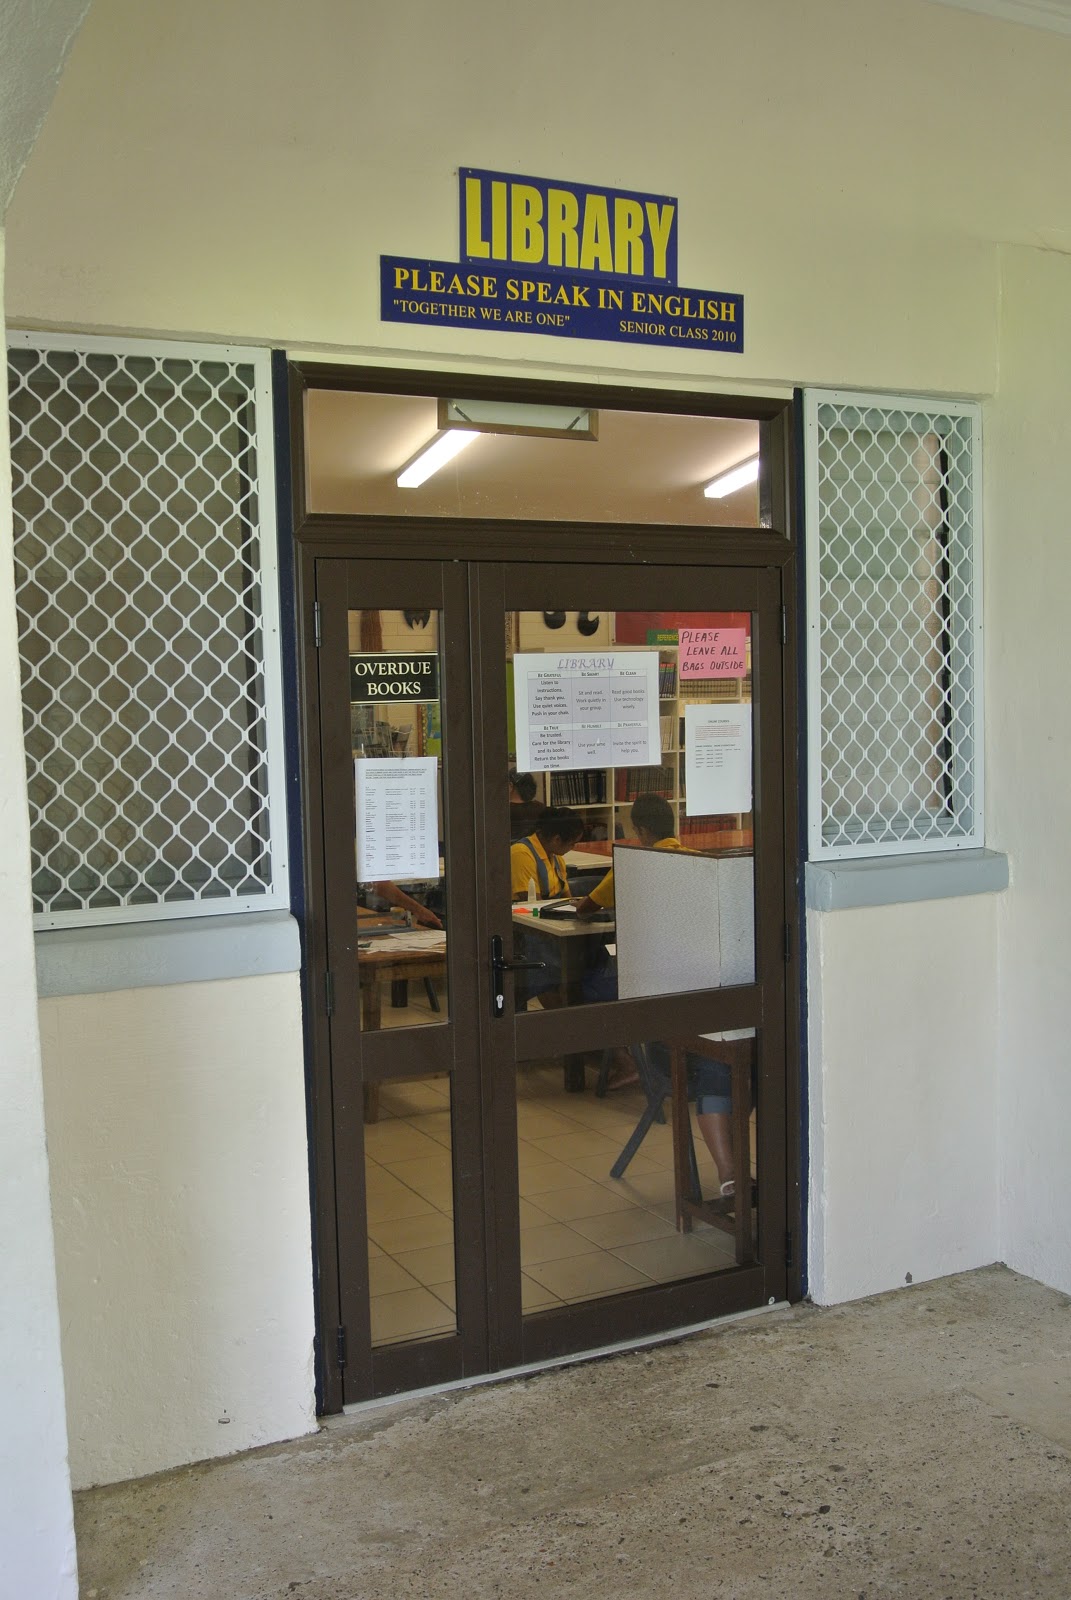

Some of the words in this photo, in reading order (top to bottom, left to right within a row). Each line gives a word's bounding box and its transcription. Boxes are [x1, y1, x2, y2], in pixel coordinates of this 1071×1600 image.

[466, 178, 674, 278] LIBRARY
[394, 268, 497, 298] PLEASE
[506, 279, 590, 307] SPEAK
[598, 288, 624, 311] IN
[632, 292, 736, 322] ENGLISH
[393, 299, 476, 319] "TOGETHER
[480, 307, 501, 321] WE
[505, 310, 533, 324] ARE
[536, 312, 570, 327] ONE"
[620, 320, 666, 336] SENIOR
[669, 325, 709, 340] CLASS
[711, 329, 737, 343] 2010
[681, 631, 719, 643] PLEASE
[686, 646, 716, 656] LEAVE
[720, 646, 738, 655] ALL
[355, 662, 432, 676] OVERDUE
[557, 658, 614, 670] LIBRARY
[682, 661, 704, 671] BAGS
[710, 661, 744, 670] OUTSIDE
[367, 681, 421, 696] BOOKS
